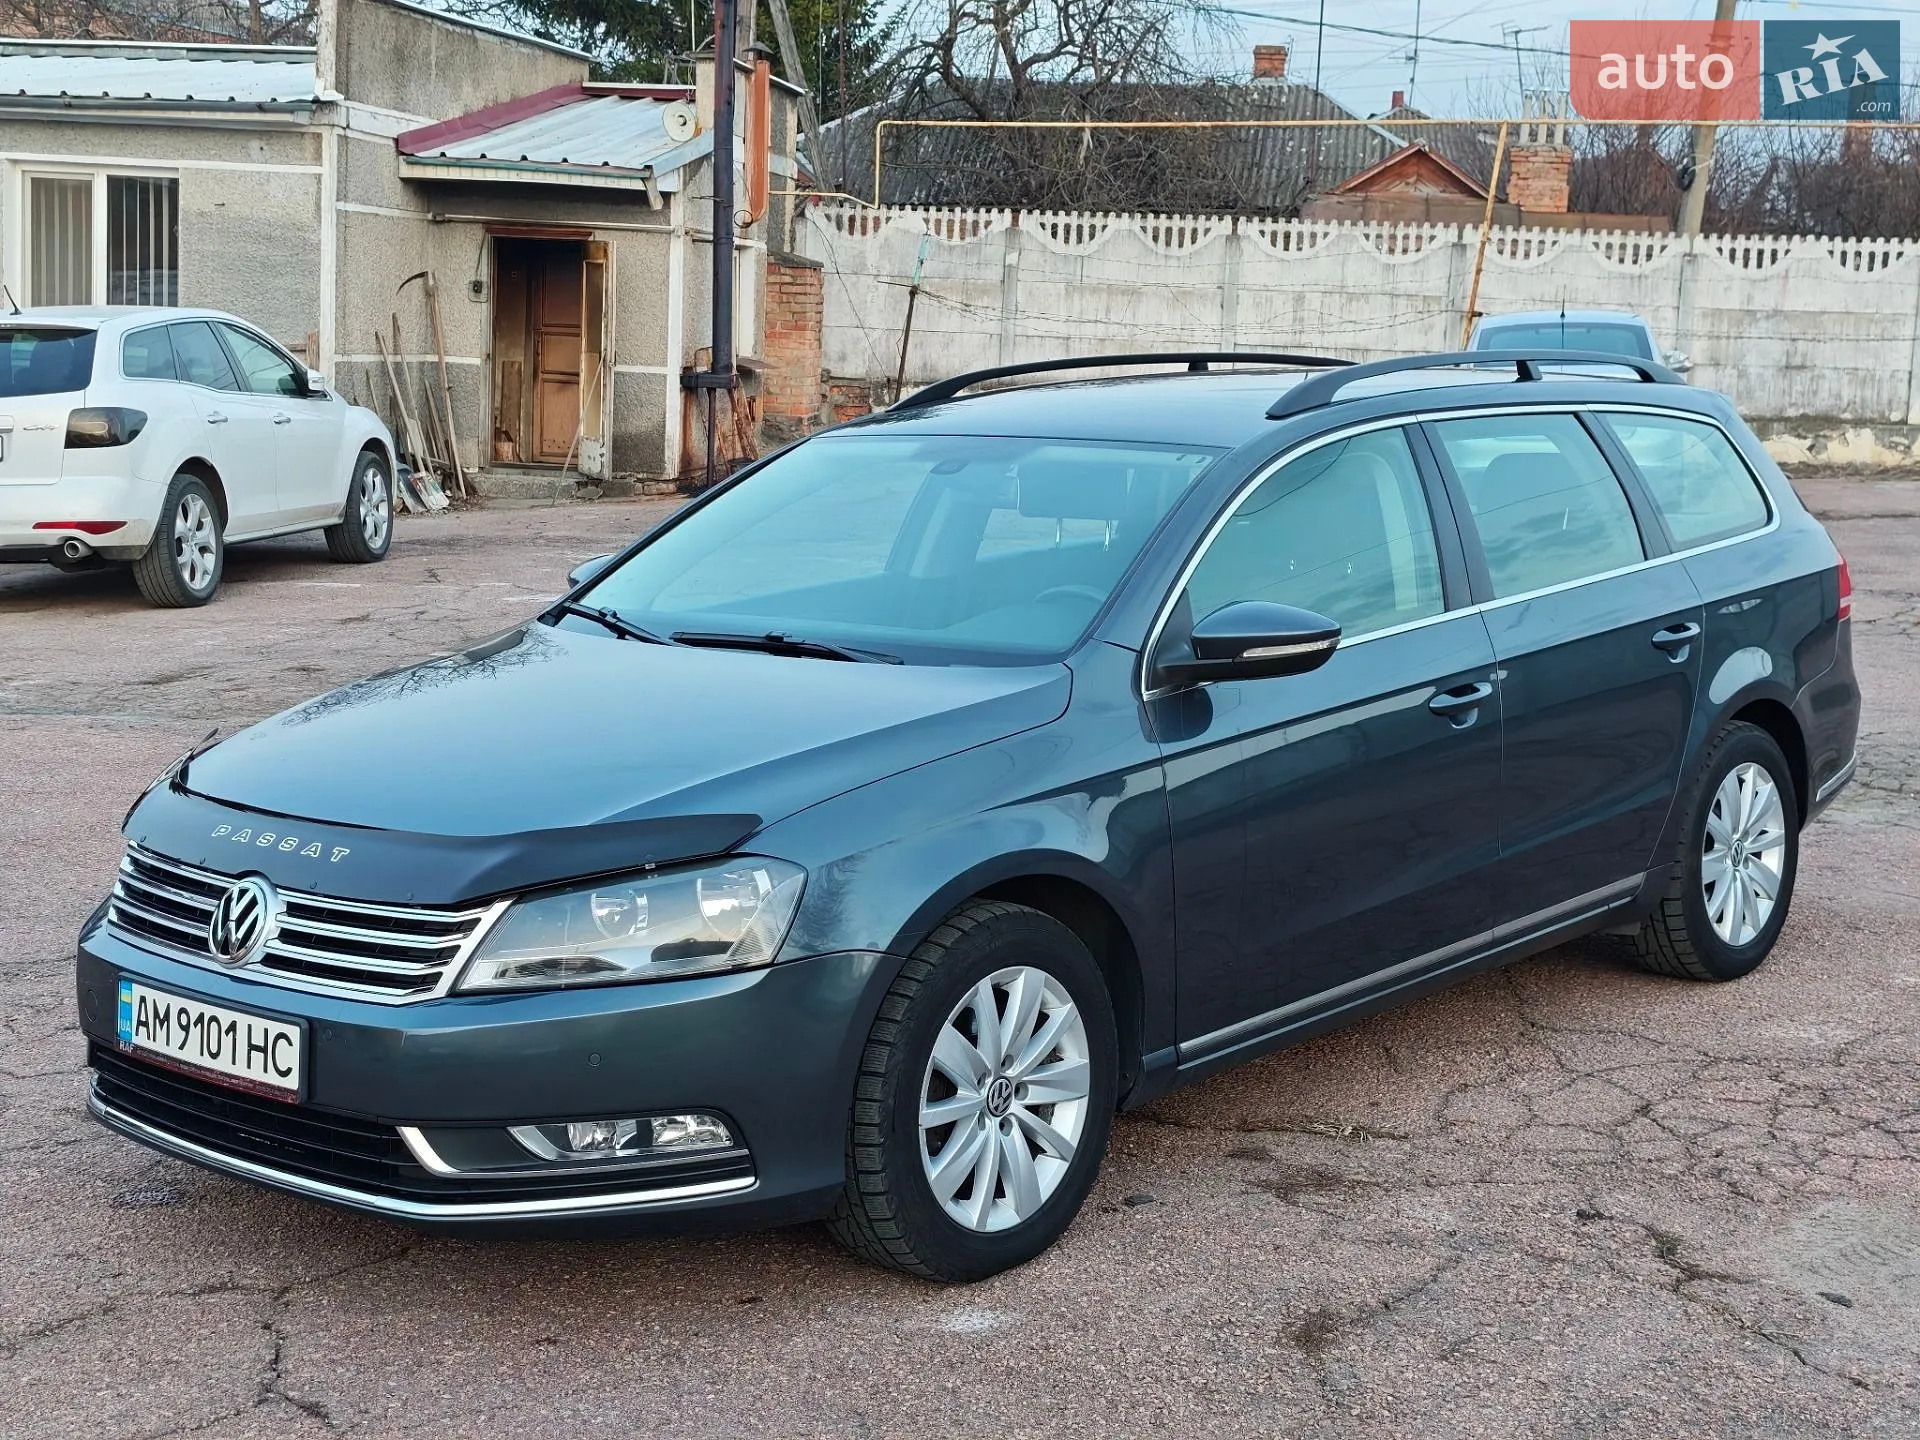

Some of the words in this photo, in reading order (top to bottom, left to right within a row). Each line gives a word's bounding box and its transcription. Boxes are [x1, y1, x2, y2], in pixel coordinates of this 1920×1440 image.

[211, 824, 351, 863] PASSAT
[119, 1017, 132, 1034] UA
[135, 995, 171, 1047] AM
[176, 1006, 238, 1066] 9101
[247, 1023, 294, 1078] HC
